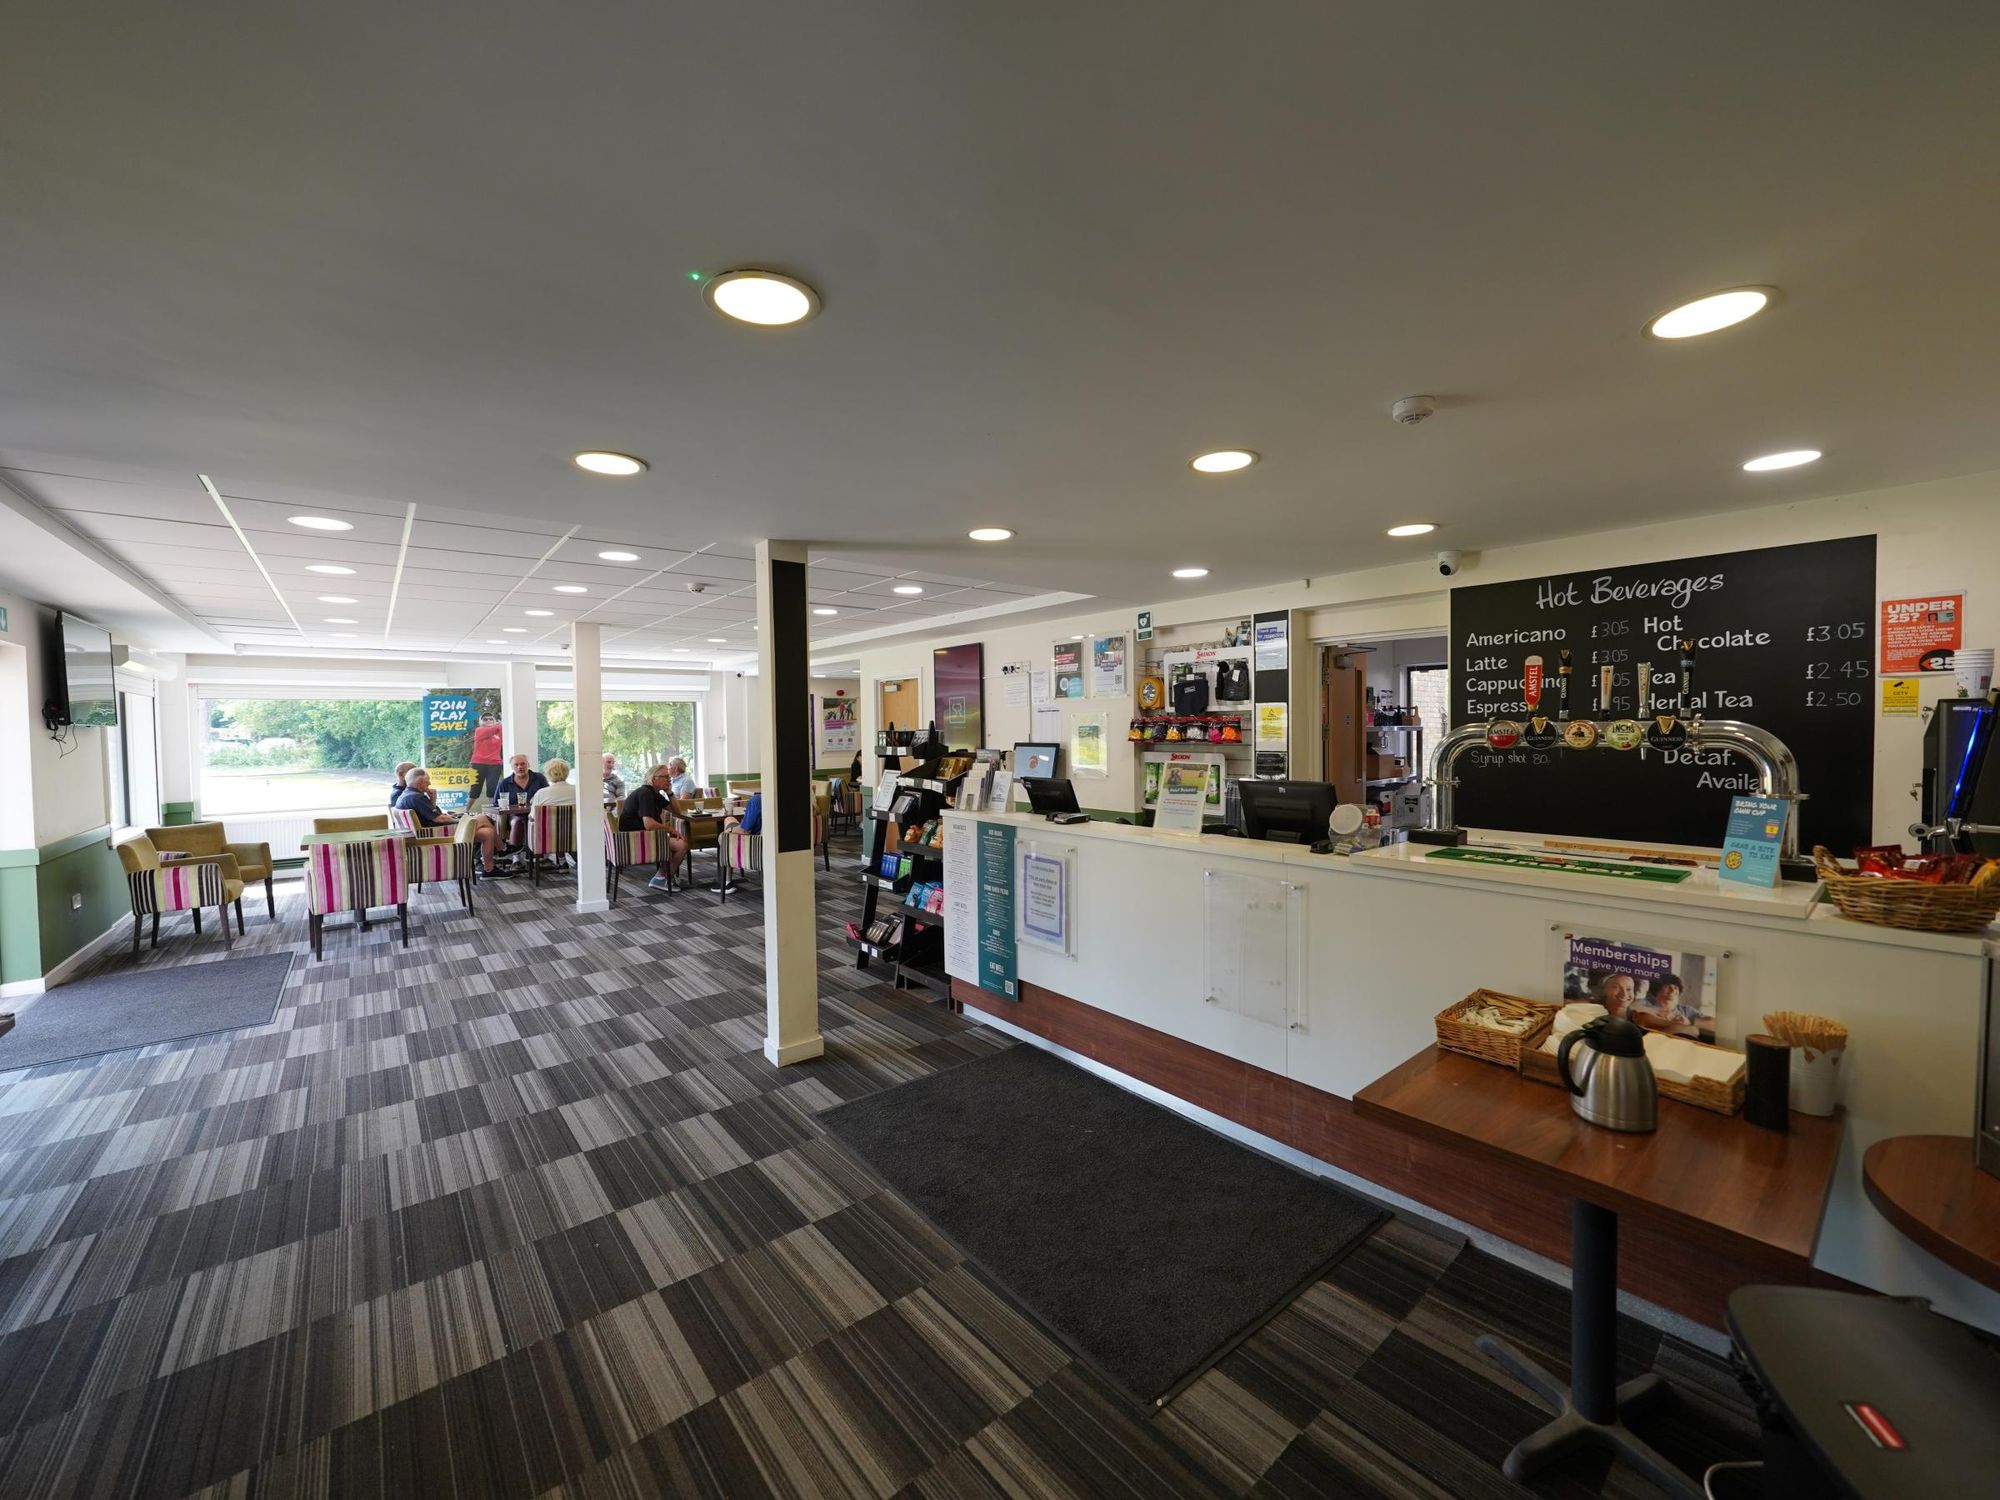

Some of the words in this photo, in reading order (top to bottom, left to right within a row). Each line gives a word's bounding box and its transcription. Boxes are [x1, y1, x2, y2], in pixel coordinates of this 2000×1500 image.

[1536, 580, 1583, 609] Hot
[1591, 573, 1724, 609] Beverages
[1888, 600, 1955, 613] UNDER
[1643, 615, 1683, 633] Hot
[1888, 613, 1920, 623] 25?
[1466, 628, 1567, 647] Americano
[1657, 629, 1771, 651] Chcolate
[1466, 656, 1508, 672] Latte
[1466, 672, 1562, 696] Cappucino
[1529, 666, 1538, 697] AMSTEL
[1650, 668, 1676, 684] ea
[429, 700, 467, 711] JOIN
[1467, 699, 1538, 717] Espress
[1714, 690, 1753, 708] Tea
[430, 711, 467, 721] PLAY
[430, 720, 468, 732] SAVE!
[1471, 750, 1504, 768] Syrup
[1507, 750, 1527, 764] shot
[1664, 750, 1736, 766] Decaf.
[448, 775, 470, 785] £86
[1735, 800, 1758, 809] BRING
[1759, 802, 1777, 811] YOUR
[1572, 941, 1670, 968] Memberships
[1572, 956, 1589, 966] that
[1592, 961, 1612, 971] give
[1614, 964, 1632, 974] you
[1635, 968, 1661, 979] more
